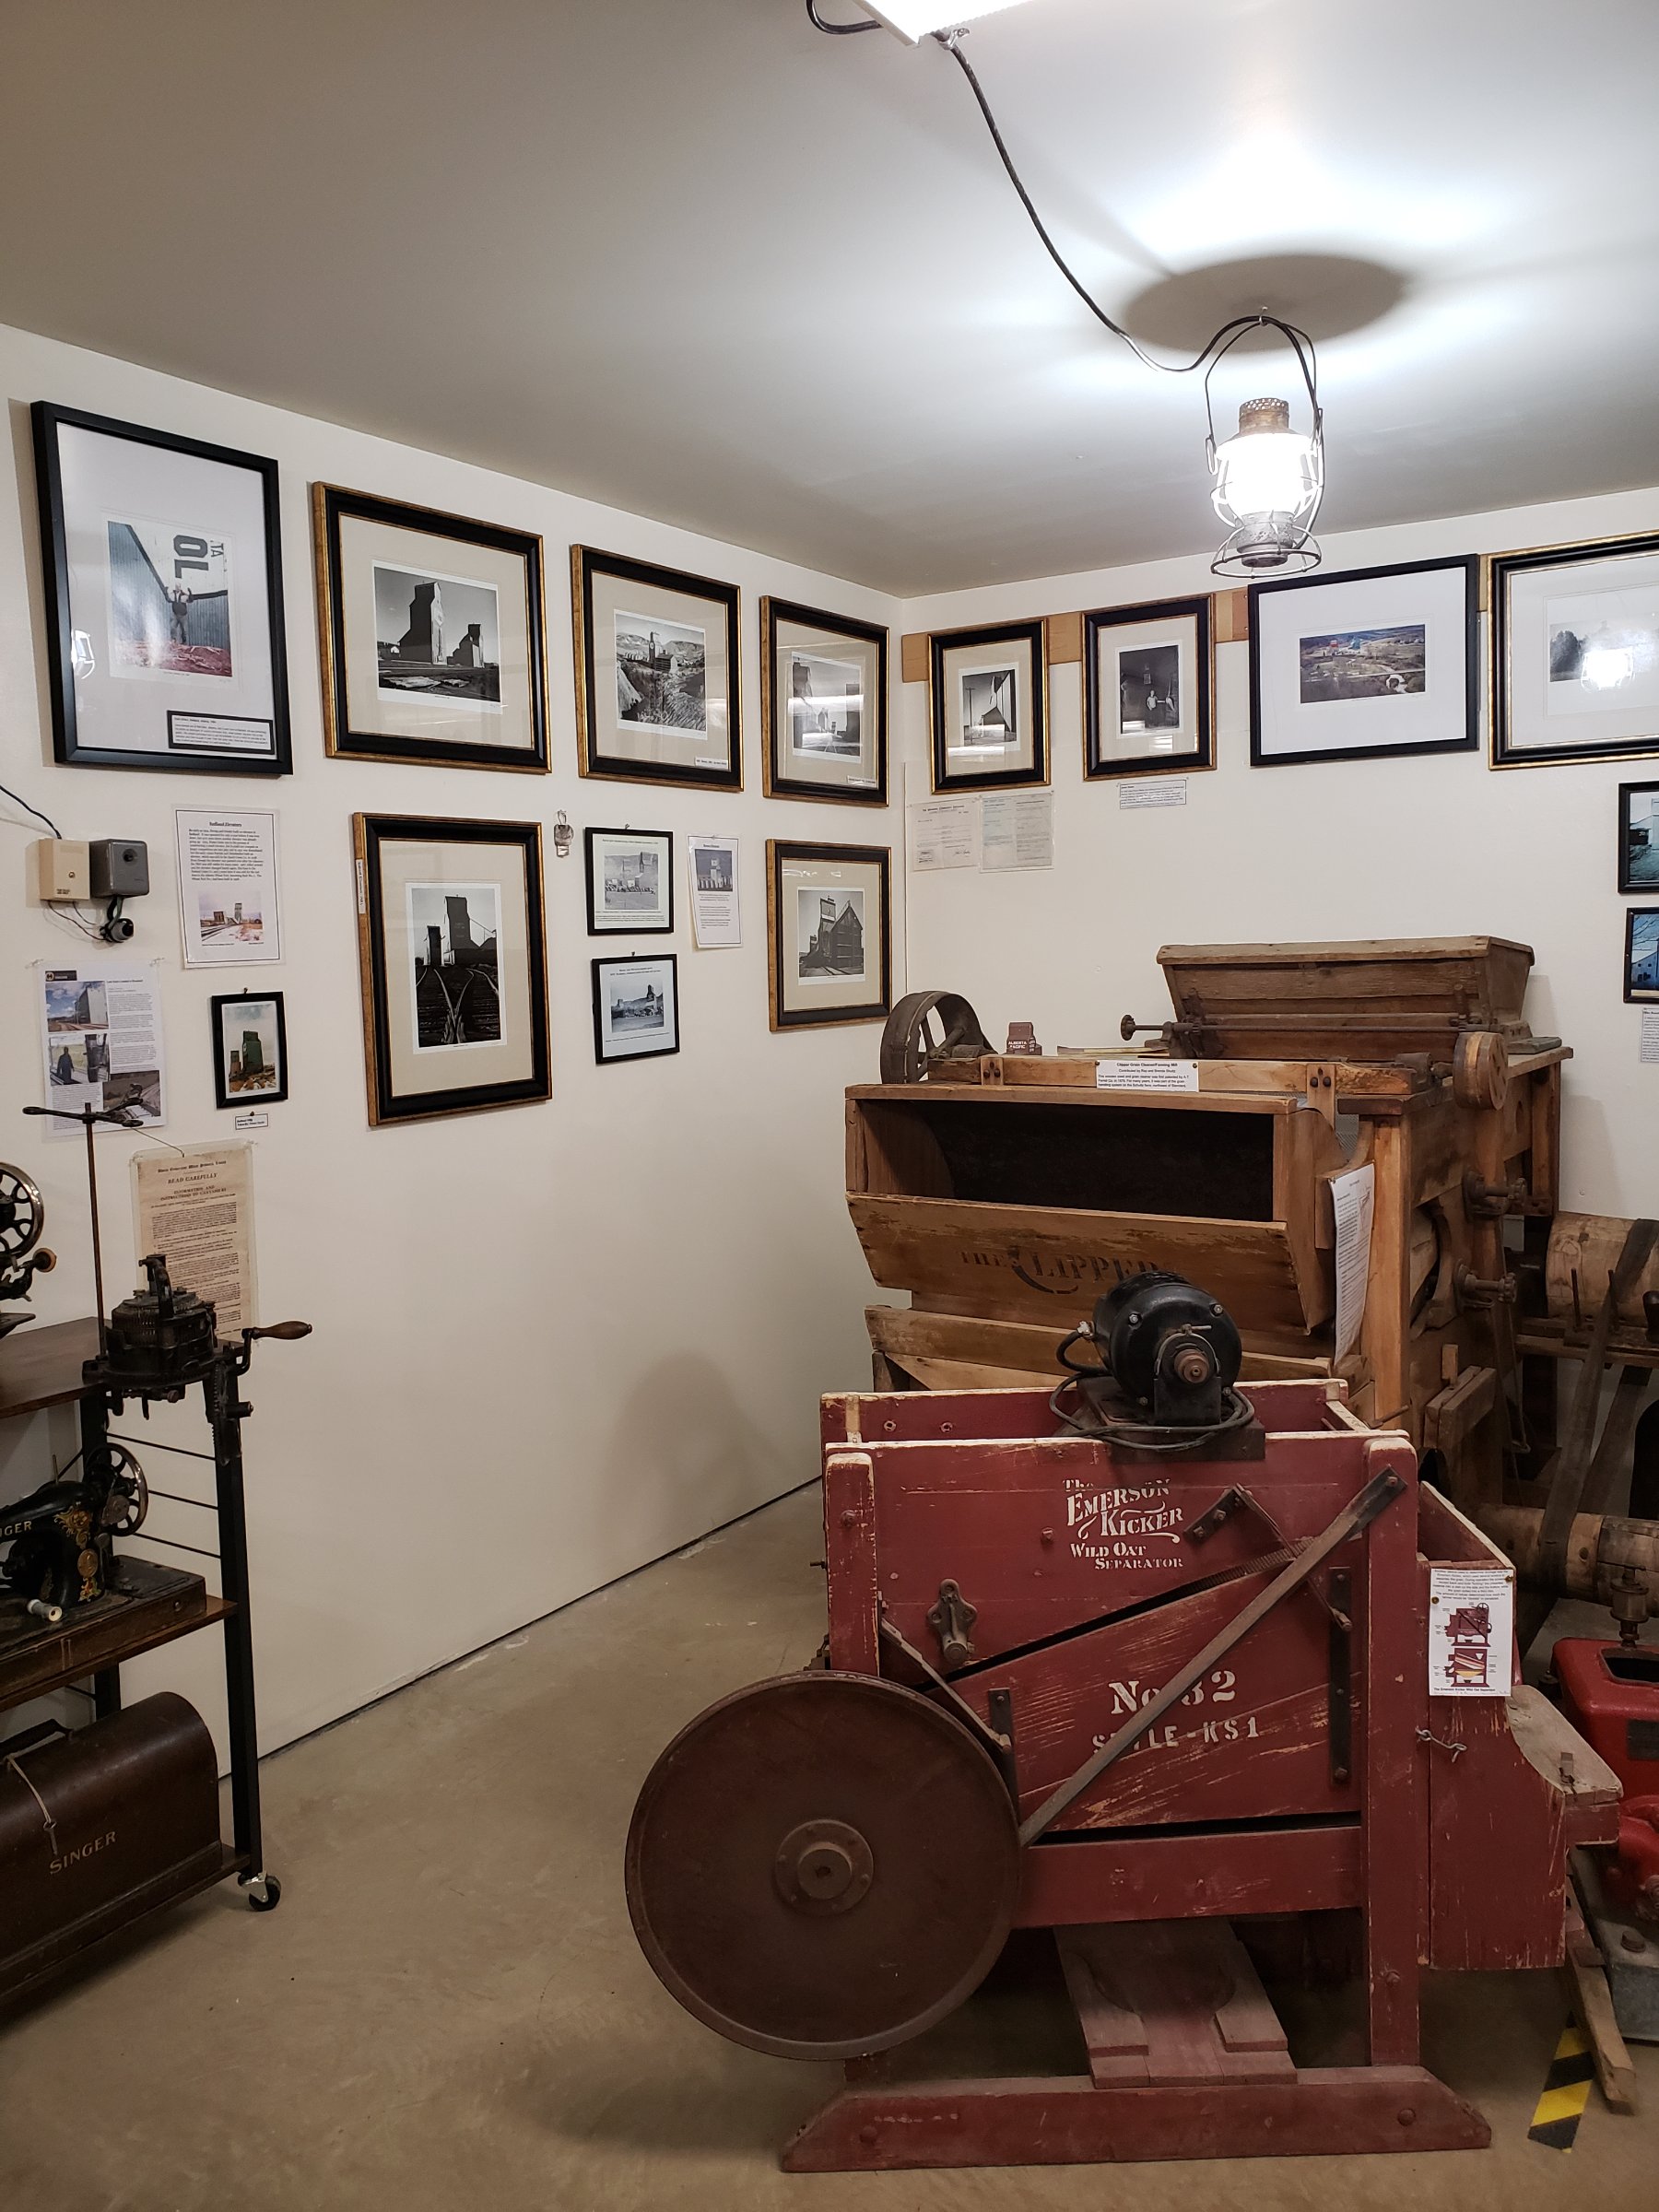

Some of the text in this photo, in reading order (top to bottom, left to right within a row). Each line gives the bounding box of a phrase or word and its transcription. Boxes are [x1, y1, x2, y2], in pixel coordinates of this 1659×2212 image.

[210, 540, 224, 558] TA
[1066, 1478, 1171, 1526] EMERSON
[1100, 1507, 1183, 1536] KICKER
[1070, 1541, 1147, 1558] WILD OAT
[1095, 1558, 1183, 1570] SEPARATOR
[49, 1831, 116, 1875] SINGER
